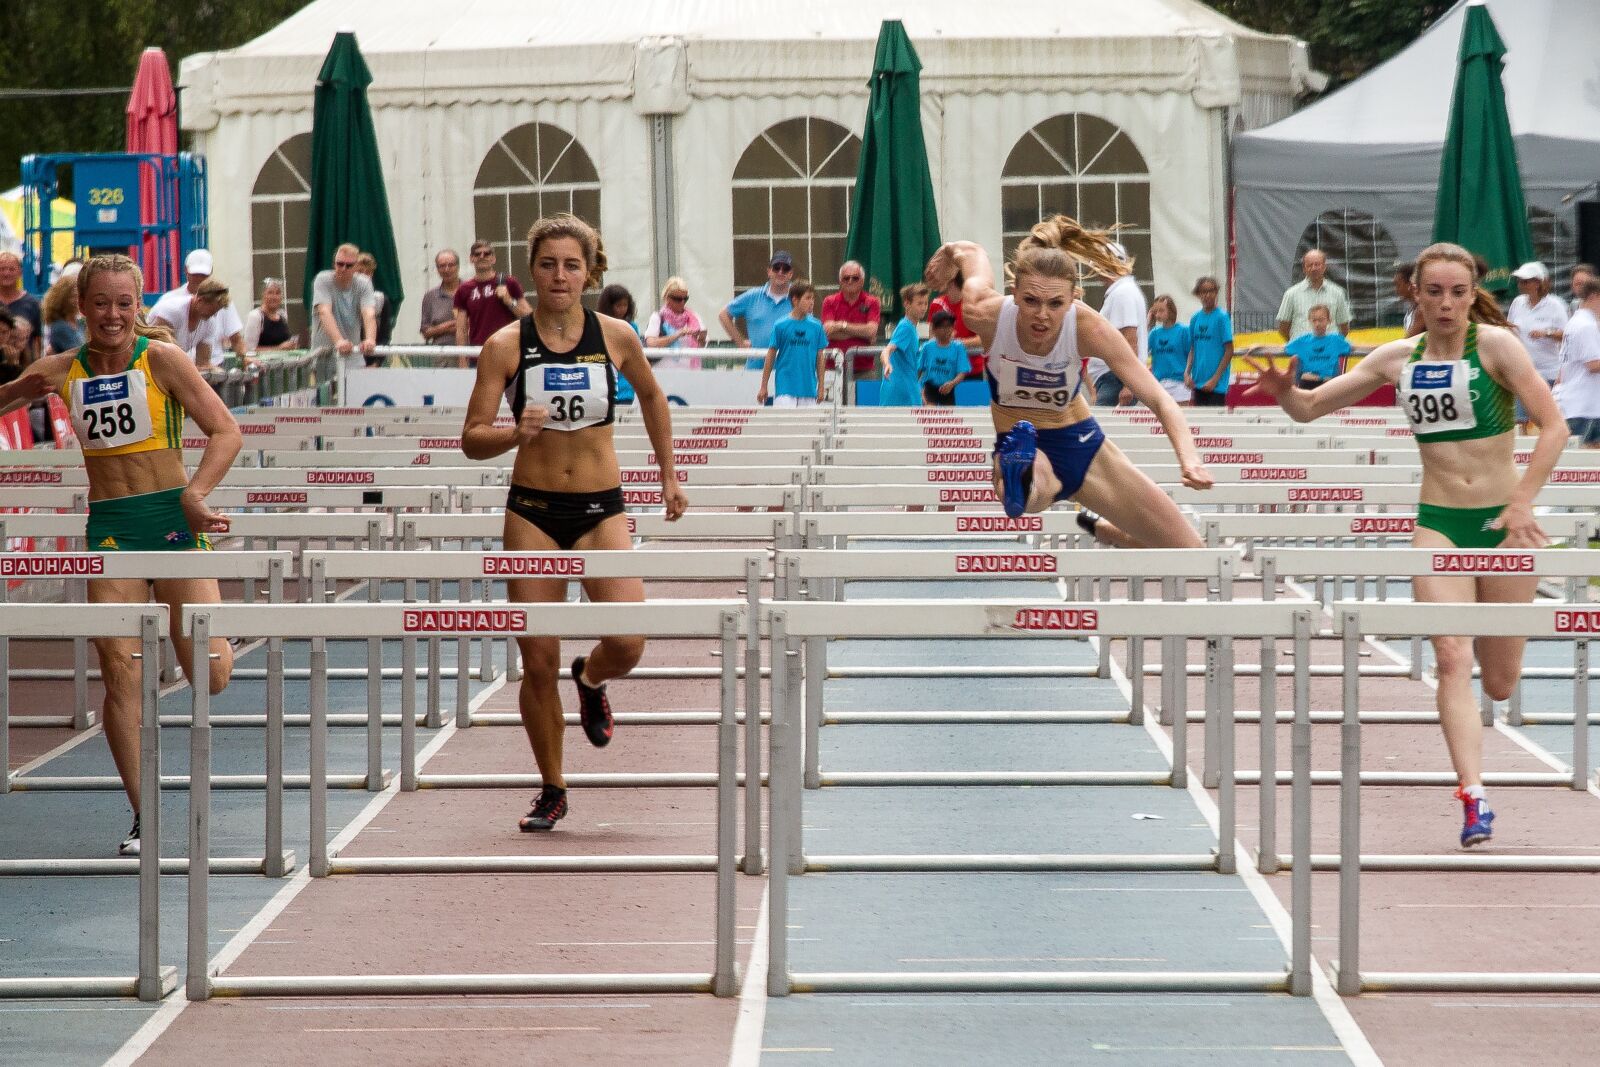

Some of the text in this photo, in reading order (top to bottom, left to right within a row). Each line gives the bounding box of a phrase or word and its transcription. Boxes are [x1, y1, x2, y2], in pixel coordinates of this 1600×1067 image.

[88, 187, 125, 206] 326
[98, 381, 124, 392] BASF
[550, 394, 586, 423] 36
[1407, 392, 1459, 425] 398
[82, 402, 136, 441] 258
[419, 440, 463, 449] BAUHA
[673, 440, 728, 449] BAUHAUS
[928, 440, 982, 448] BAUHAUS
[649, 454, 708, 464] BHAUS
[927, 453, 985, 463] BAUHAUS
[1203, 453, 1263, 463] BAUHAUS
[0, 472, 62, 482] AUHAUS
[307, 472, 373, 482] BAUHAUS
[621, 471, 687, 482] BAUHS
[928, 471, 993, 481] BAUHAUS
[1241, 469, 1307, 479] BAUHAUS
[247, 493, 307, 502] BAUHAUS
[1288, 489, 1362, 500] BAUHAUS
[957, 518, 1042, 530] BAUHAUS
[2, 558, 102, 573] BAUHAUS
[484, 559, 583, 573] BAUHAUS
[957, 557, 1056, 571] BAUHAUS
[1433, 556, 1534, 570] BAUHAUS
[405, 613, 526, 629] BAUHAUS
